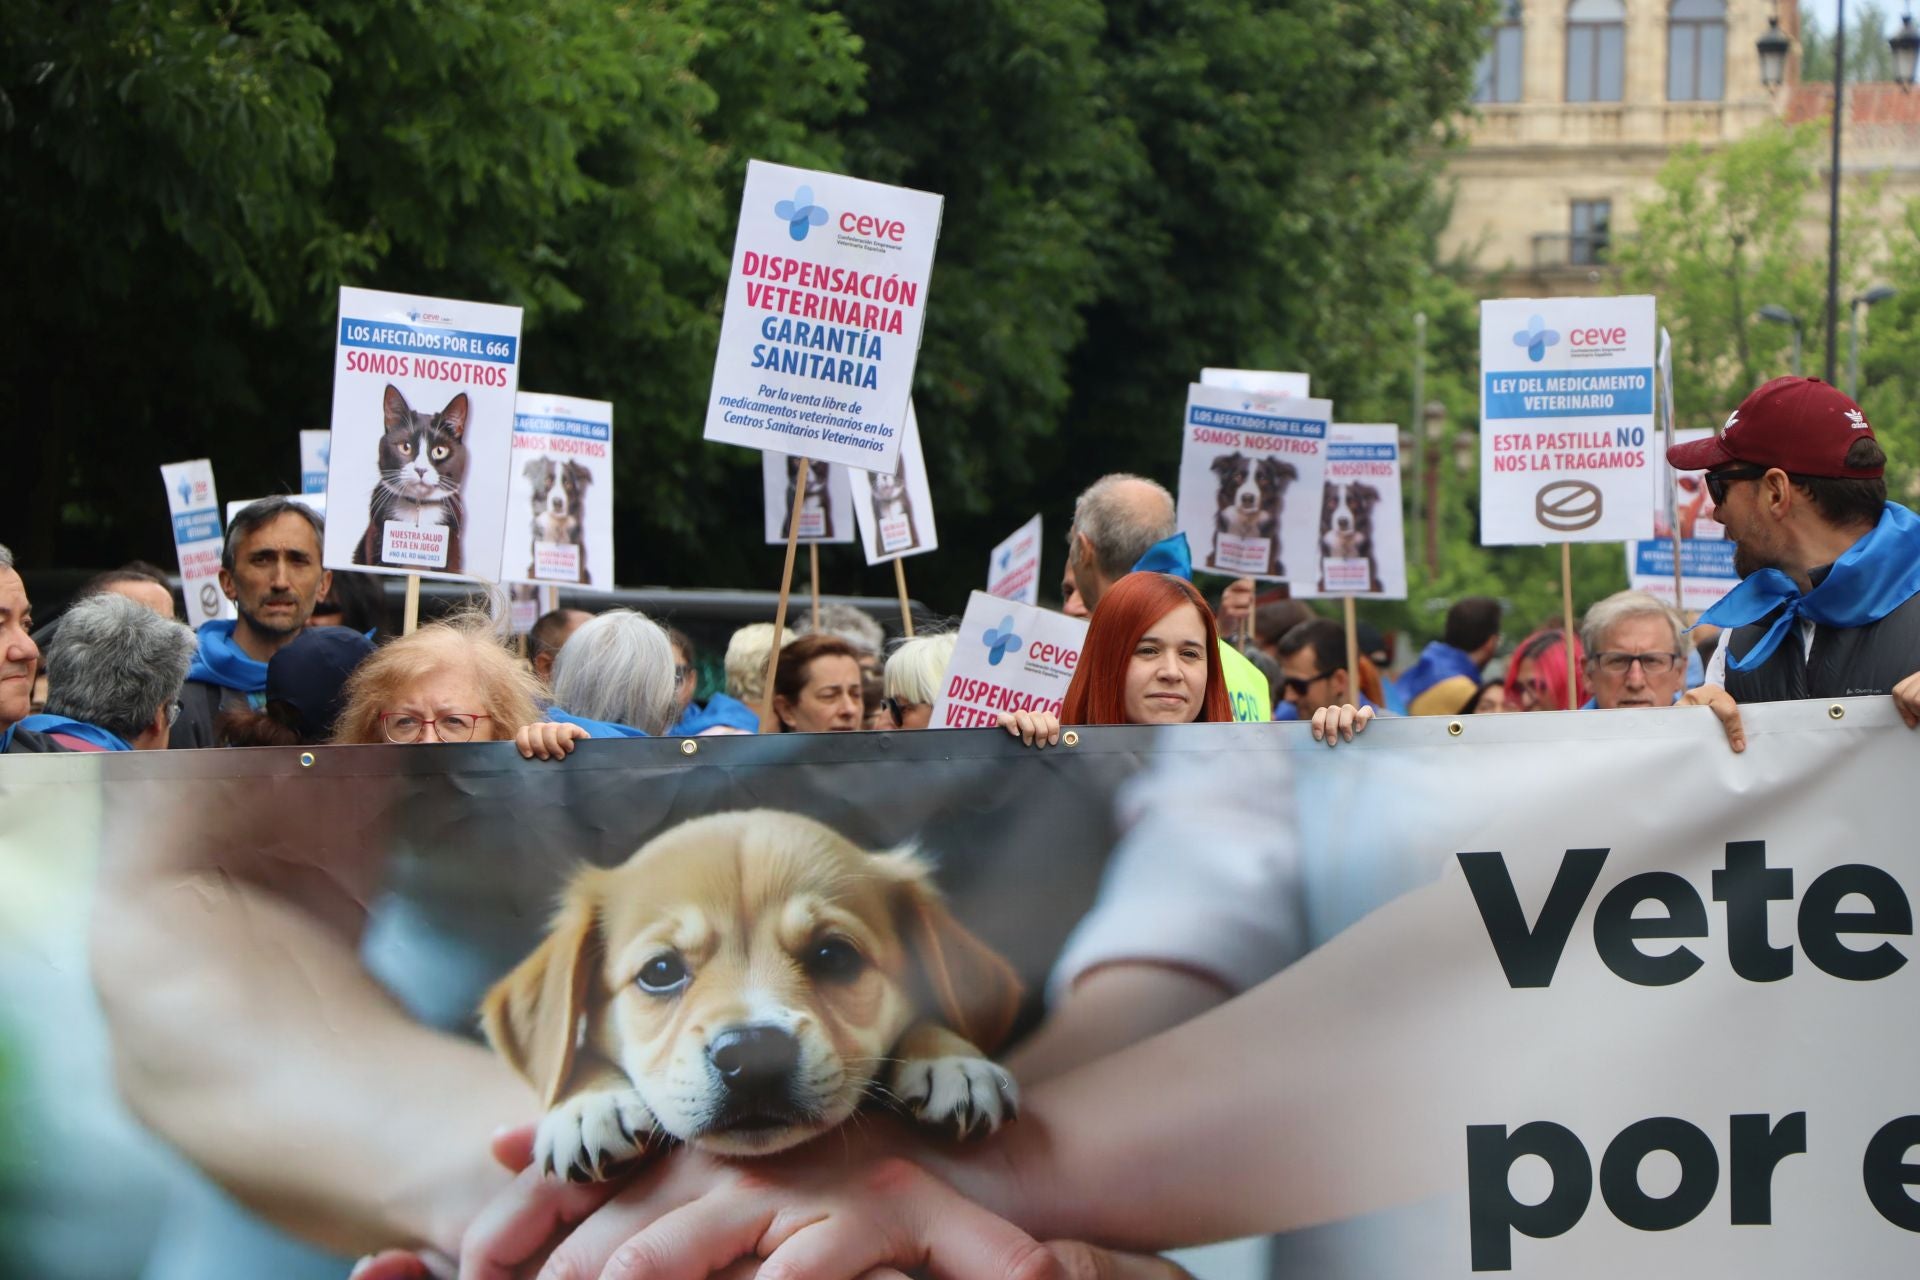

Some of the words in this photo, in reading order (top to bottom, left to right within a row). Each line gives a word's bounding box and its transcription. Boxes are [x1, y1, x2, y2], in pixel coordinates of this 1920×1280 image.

[840, 212, 905, 242] ceve
[742, 251, 917, 307] DISPENSACIÓN
[747, 282, 903, 335] VETERINARIA
[347, 325, 369, 342] LOS
[372, 327, 440, 350] AFECTADOS
[443, 336, 467, 352] POR
[471, 339, 483, 354] EL
[486, 342, 509, 357] 666
[761, 316, 882, 361] GARANTÍA
[1570, 327, 1626, 346] ceve
[346, 351, 409, 377] SOMOS
[414, 358, 507, 388] NOSOTROS
[751, 344, 877, 390] SANITARIA
[758, 384, 777, 399] Por
[778, 388, 788, 401] la
[790, 393, 820, 406] venta
[822, 396, 847, 411] libre
[848, 401, 862, 415] de
[1493, 378, 1516, 394] LEY
[1519, 378, 1543, 393] DEL
[1546, 375, 1645, 392] MEDICAMENTO
[719, 395, 797, 419] medicamentos
[800, 411, 863, 432] veterinarios
[864, 422, 877, 434] en
[879, 424, 894, 438] los
[1524, 394, 1614, 411] VETERINARIO
[724, 411, 763, 429] Centros
[765, 418, 819, 439] Sanitarios
[821, 428, 884, 452] Veterinarios
[1194, 410, 1212, 422] LOS
[1214, 412, 1266, 429] AFECTADOS
[1268, 420, 1288, 432] POR
[1290, 422, 1300, 433] EL
[1302, 423, 1321, 434] 666
[512, 434, 546, 450] OMOS
[549, 438, 605, 457] NOSOTROS
[1193, 428, 1241, 448] SOMOS
[1245, 435, 1318, 455] NOSOTROS
[1494, 434, 1532, 451] ESTA
[1536, 431, 1612, 450] PASTILLA
[1617, 427, 1645, 448] NO
[1494, 454, 1527, 472] NOS
[1531, 454, 1550, 471] LA
[1555, 451, 1645, 470] TRAGAMOS
[390, 530, 420, 540] NUESTRA
[422, 533, 443, 543] SALUD
[391, 540, 407, 549] ESTA
[410, 542, 418, 550] EN
[420, 543, 440, 552] JUEGO
[1029, 641, 1078, 669] ceve
[948, 675, 1063, 720] DISPENSACIÓ
[945, 703, 998, 728] VETER
[1455, 840, 1914, 989] Vete
[1466, 1111, 1807, 1272] por
